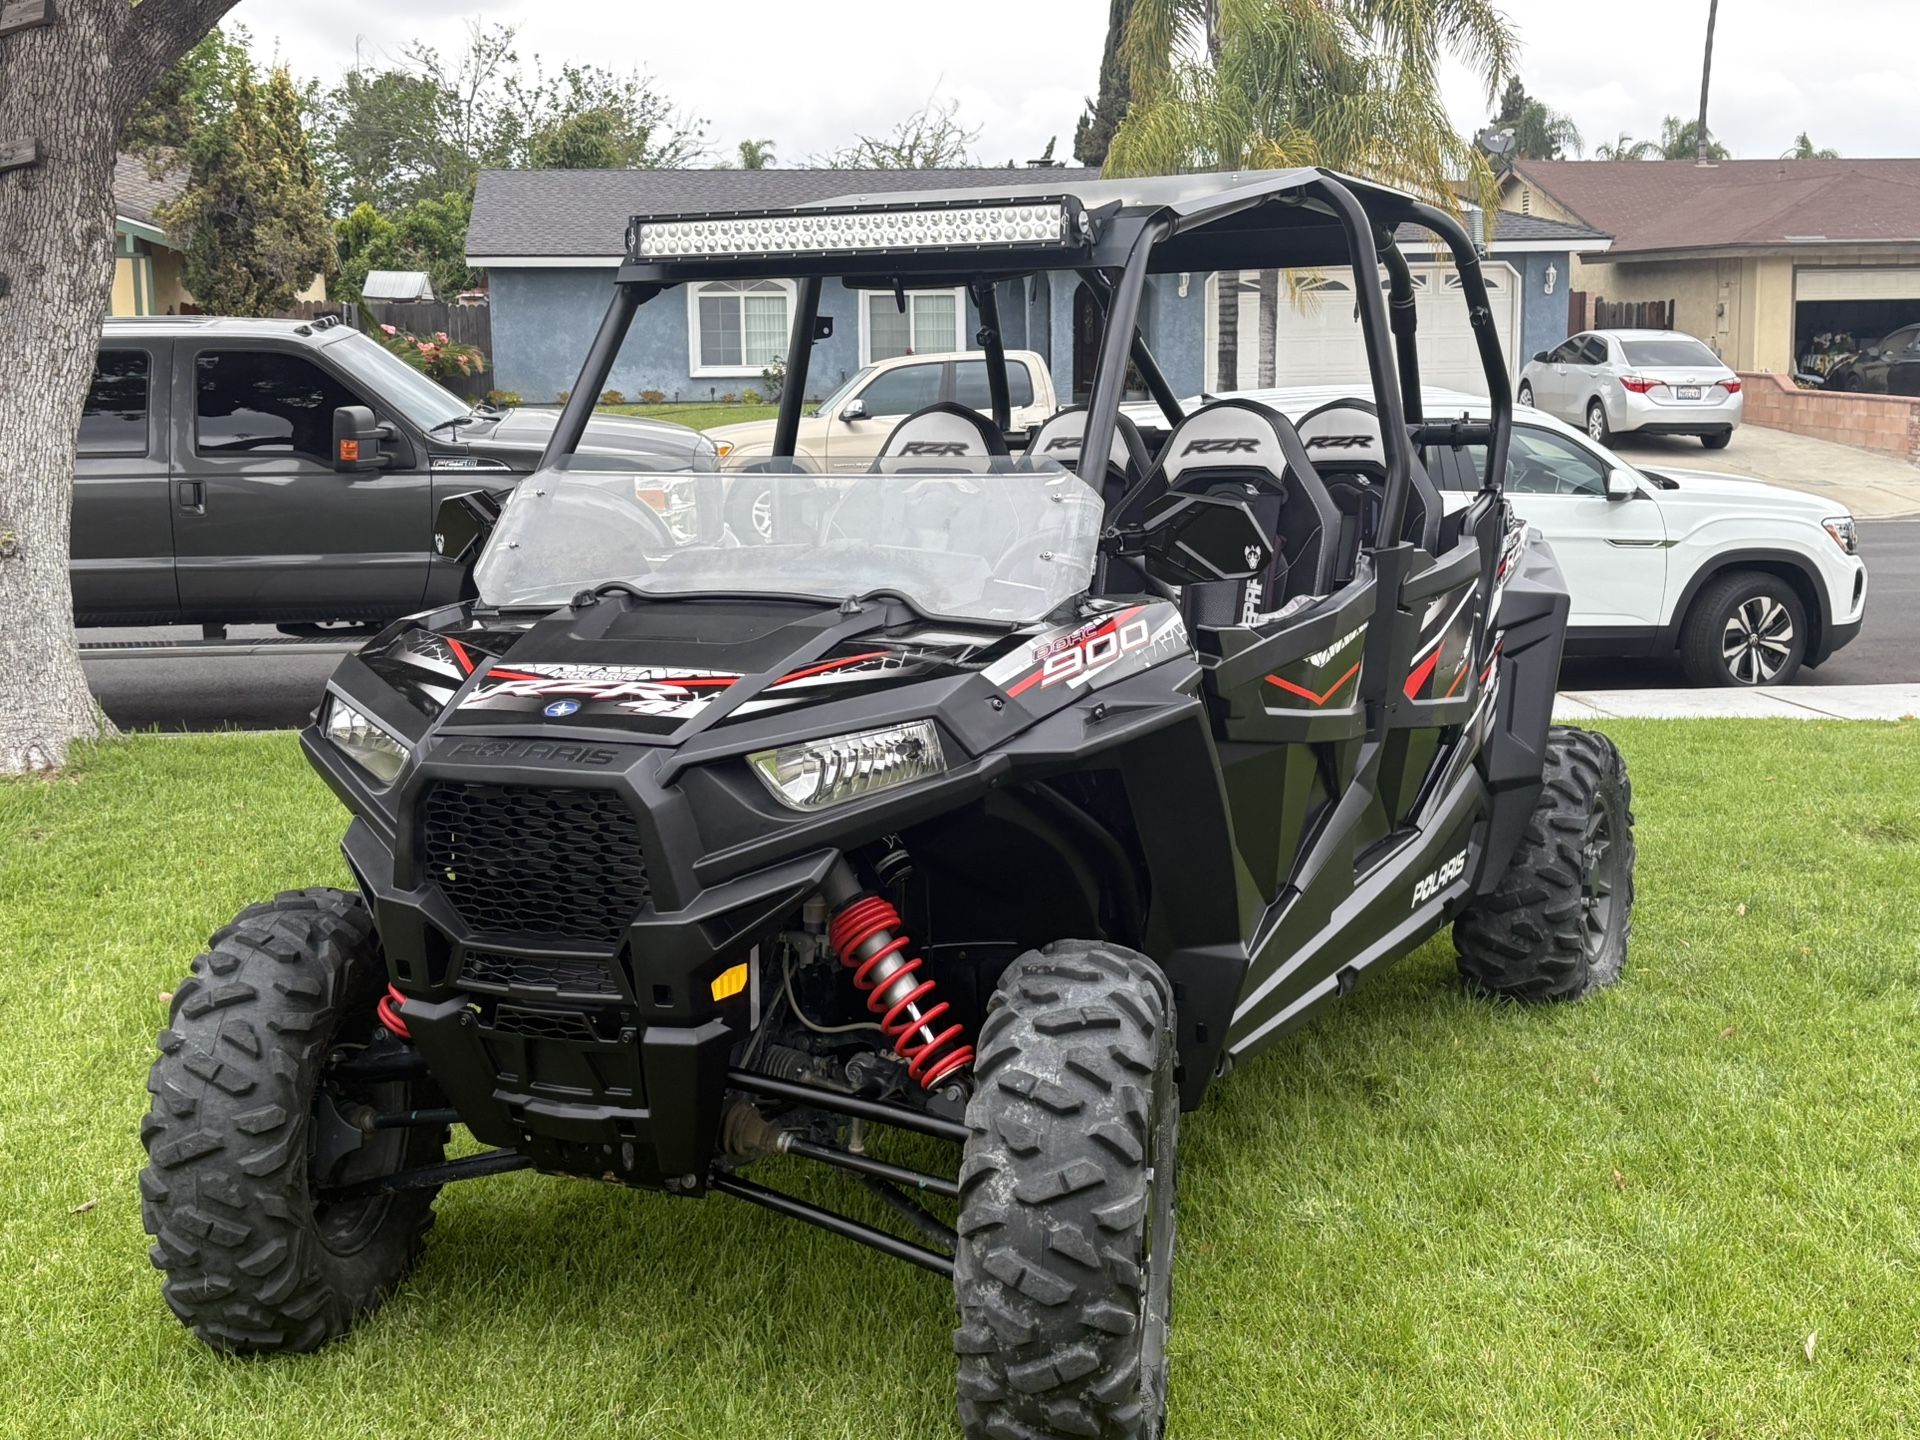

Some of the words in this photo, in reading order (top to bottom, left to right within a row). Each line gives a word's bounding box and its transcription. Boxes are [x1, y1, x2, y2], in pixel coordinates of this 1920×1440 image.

[898, 441, 970, 456] RZR
[1044, 437, 1083, 453] RZ
[1180, 438, 1262, 458] RZR
[1304, 435, 1375, 450] RZR
[1041, 619, 1149, 689] 900
[463, 679, 693, 705] RZR
[447, 742, 619, 765] POLARIS
[1411, 848, 1467, 909] POLARIS
